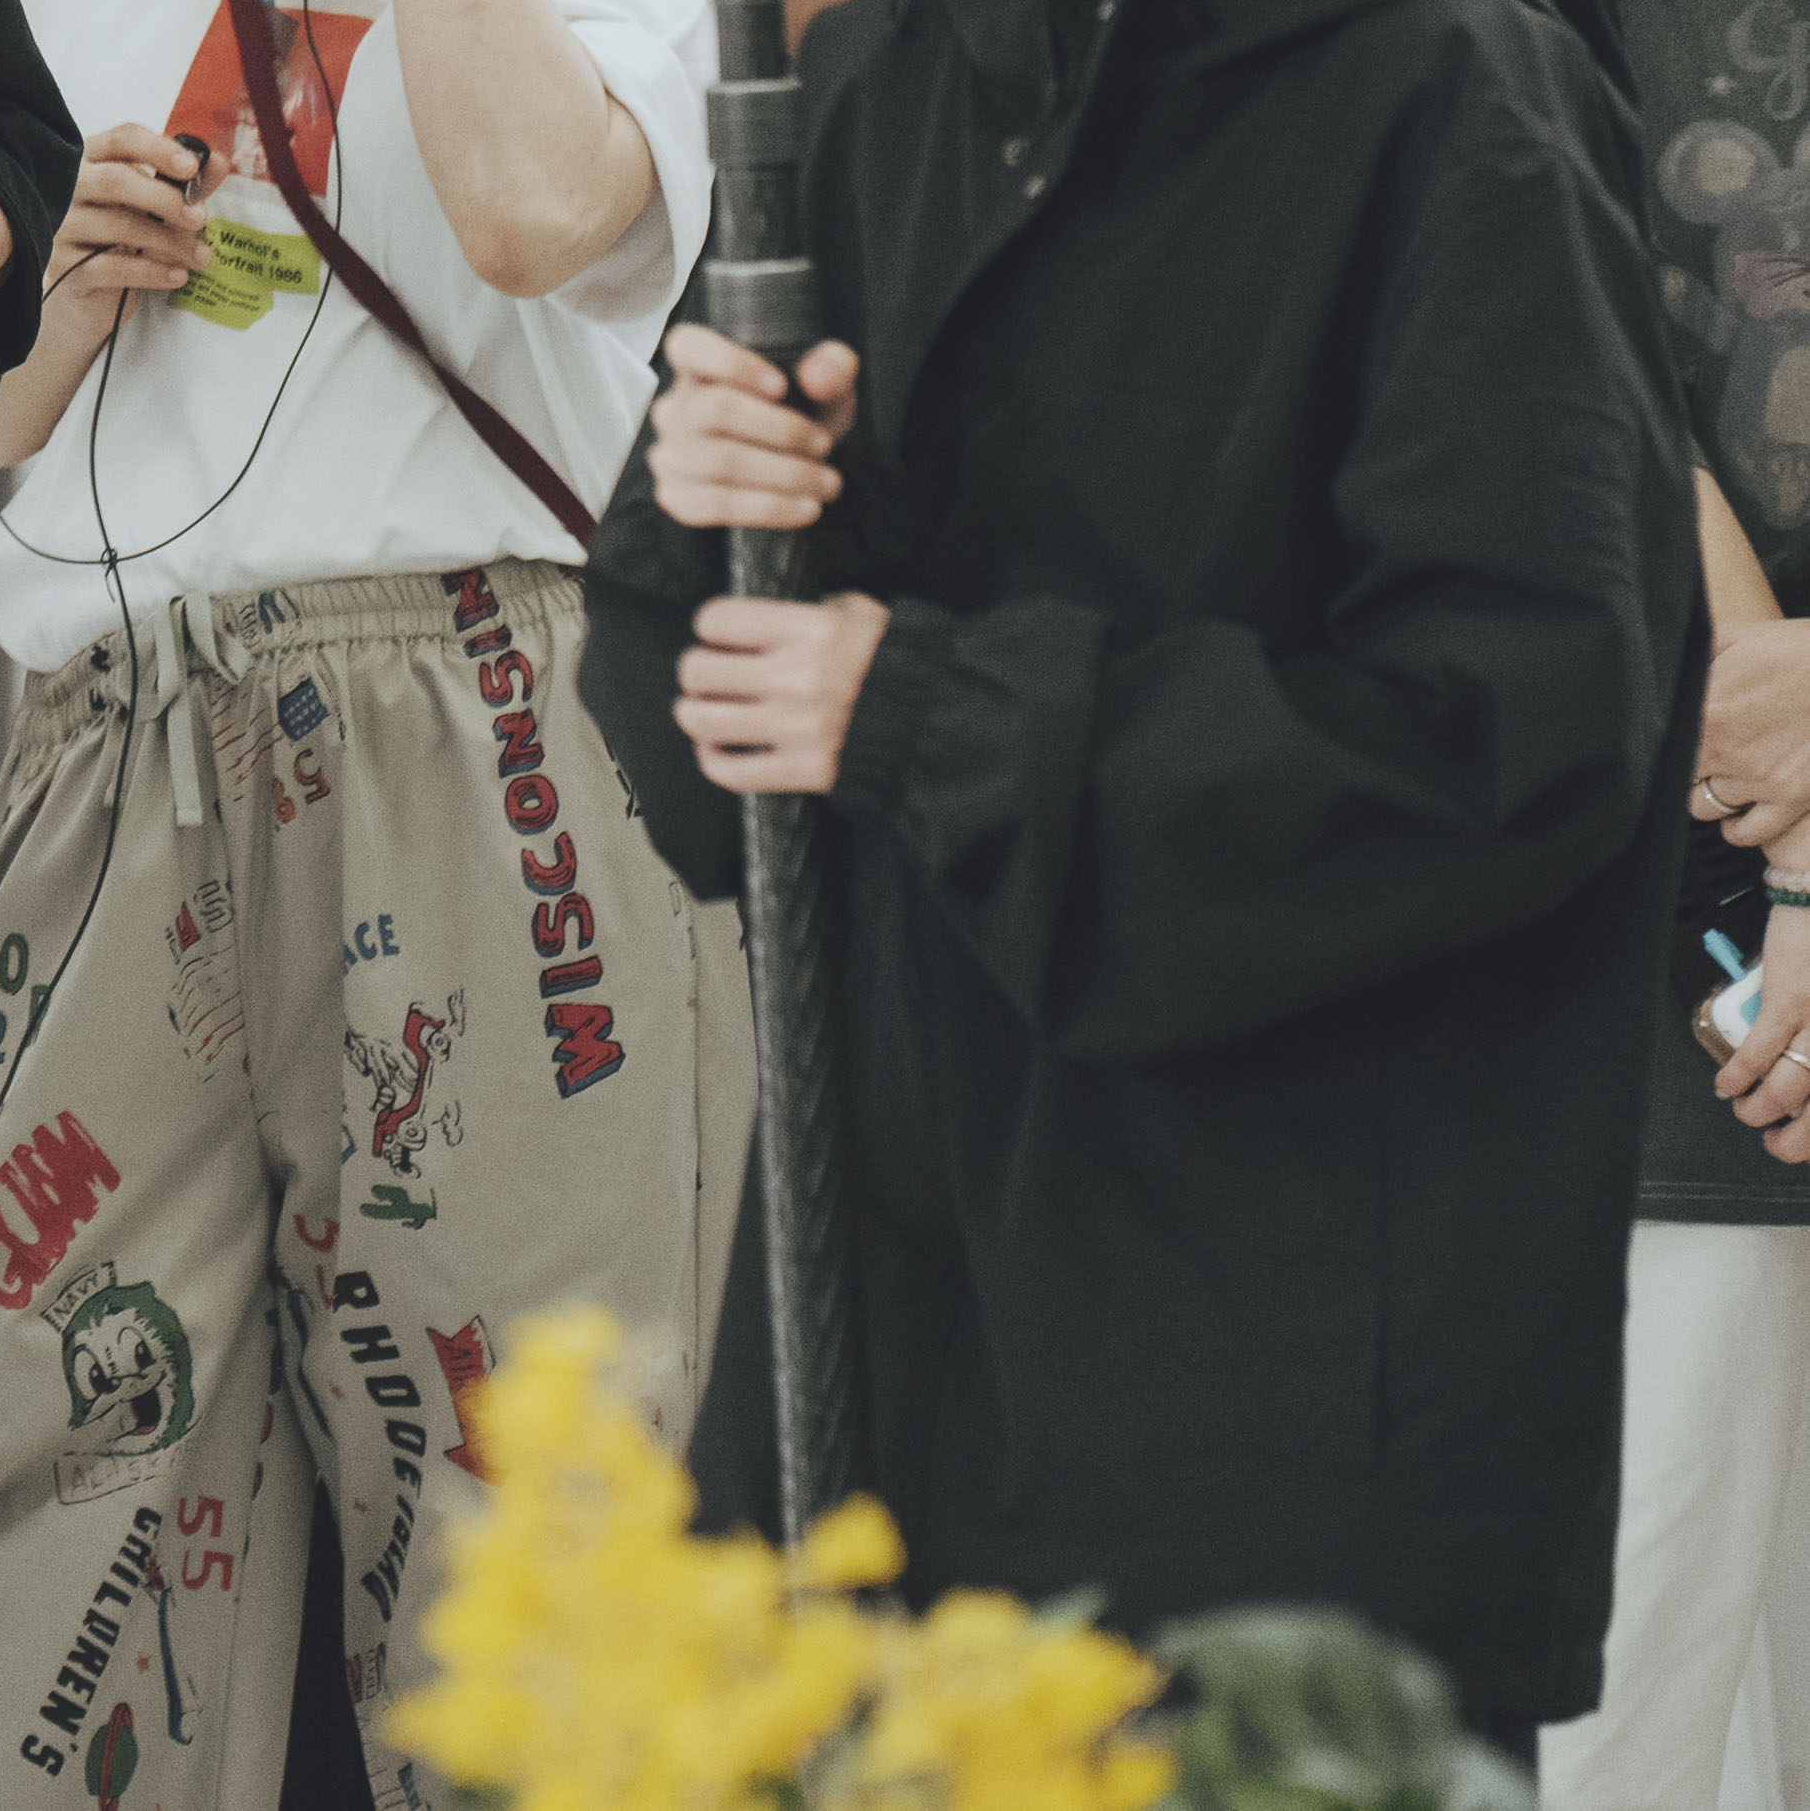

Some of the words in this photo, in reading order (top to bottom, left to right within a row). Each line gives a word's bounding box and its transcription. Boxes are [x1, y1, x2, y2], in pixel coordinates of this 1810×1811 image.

[214, 248, 263, 277] ortrait
[441, 568, 626, 1098] WISCONSIN
[19, 1507, 163, 1778] CHILDREN'S
